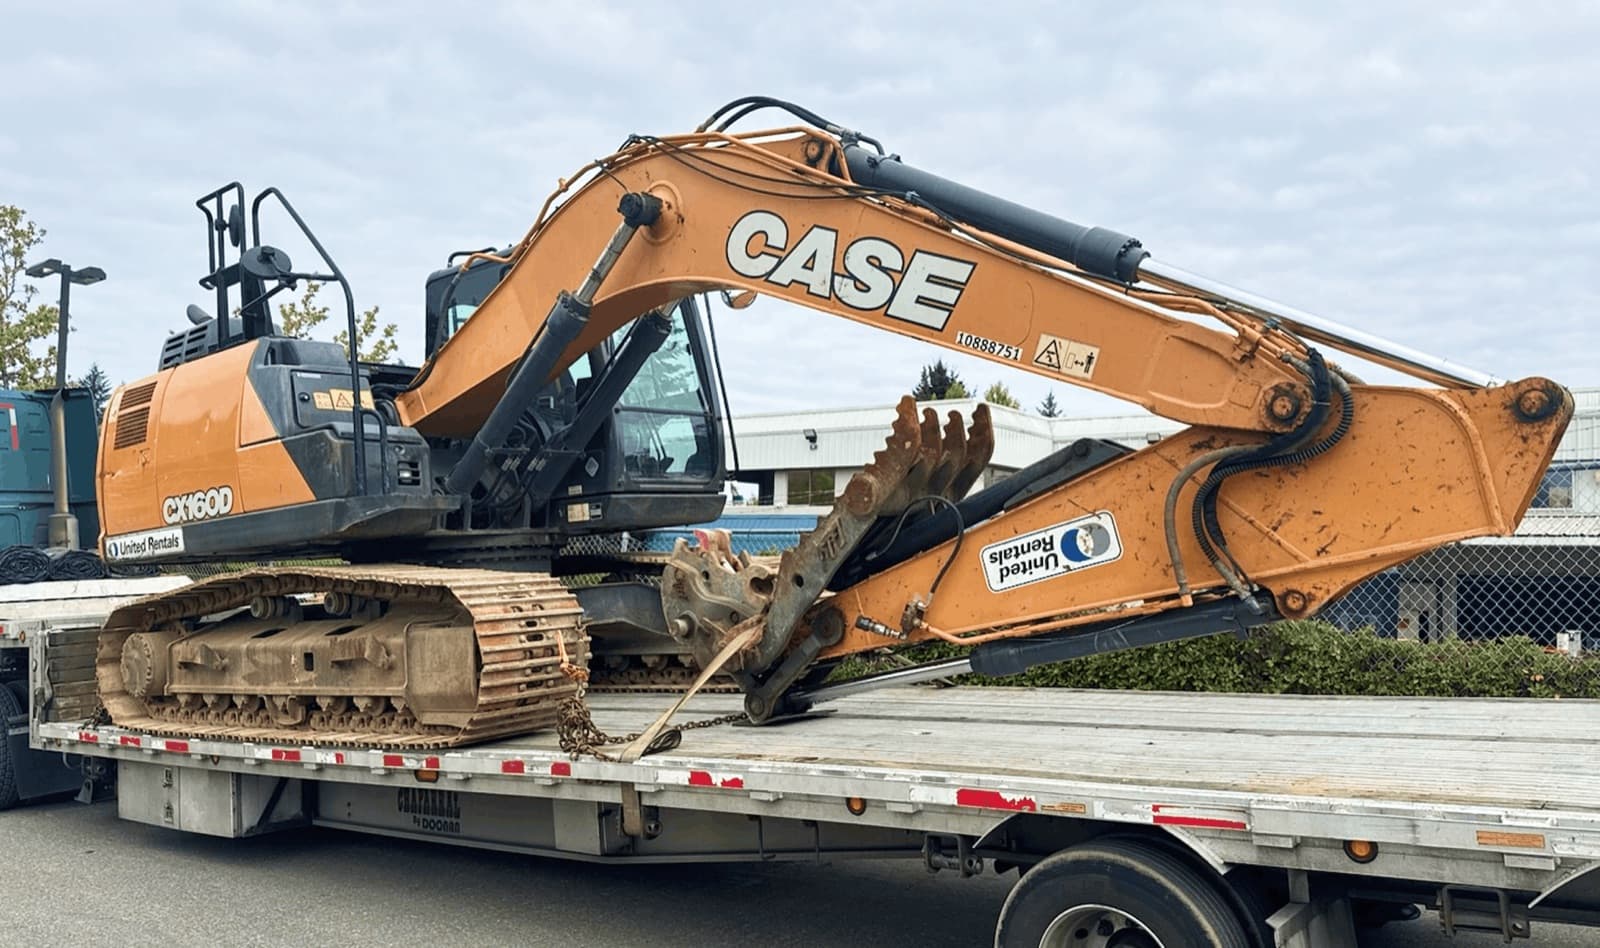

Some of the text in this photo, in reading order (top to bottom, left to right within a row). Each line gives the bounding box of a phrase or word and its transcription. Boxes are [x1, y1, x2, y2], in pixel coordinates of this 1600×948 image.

[726, 209, 978, 332] CASE
[957, 332, 1021, 361] 10888751
[162, 486, 233, 525] CX160D
[119, 533, 180, 556] United Rentals
[989, 534, 1055, 566] Rentals
[999, 552, 1060, 584] United
